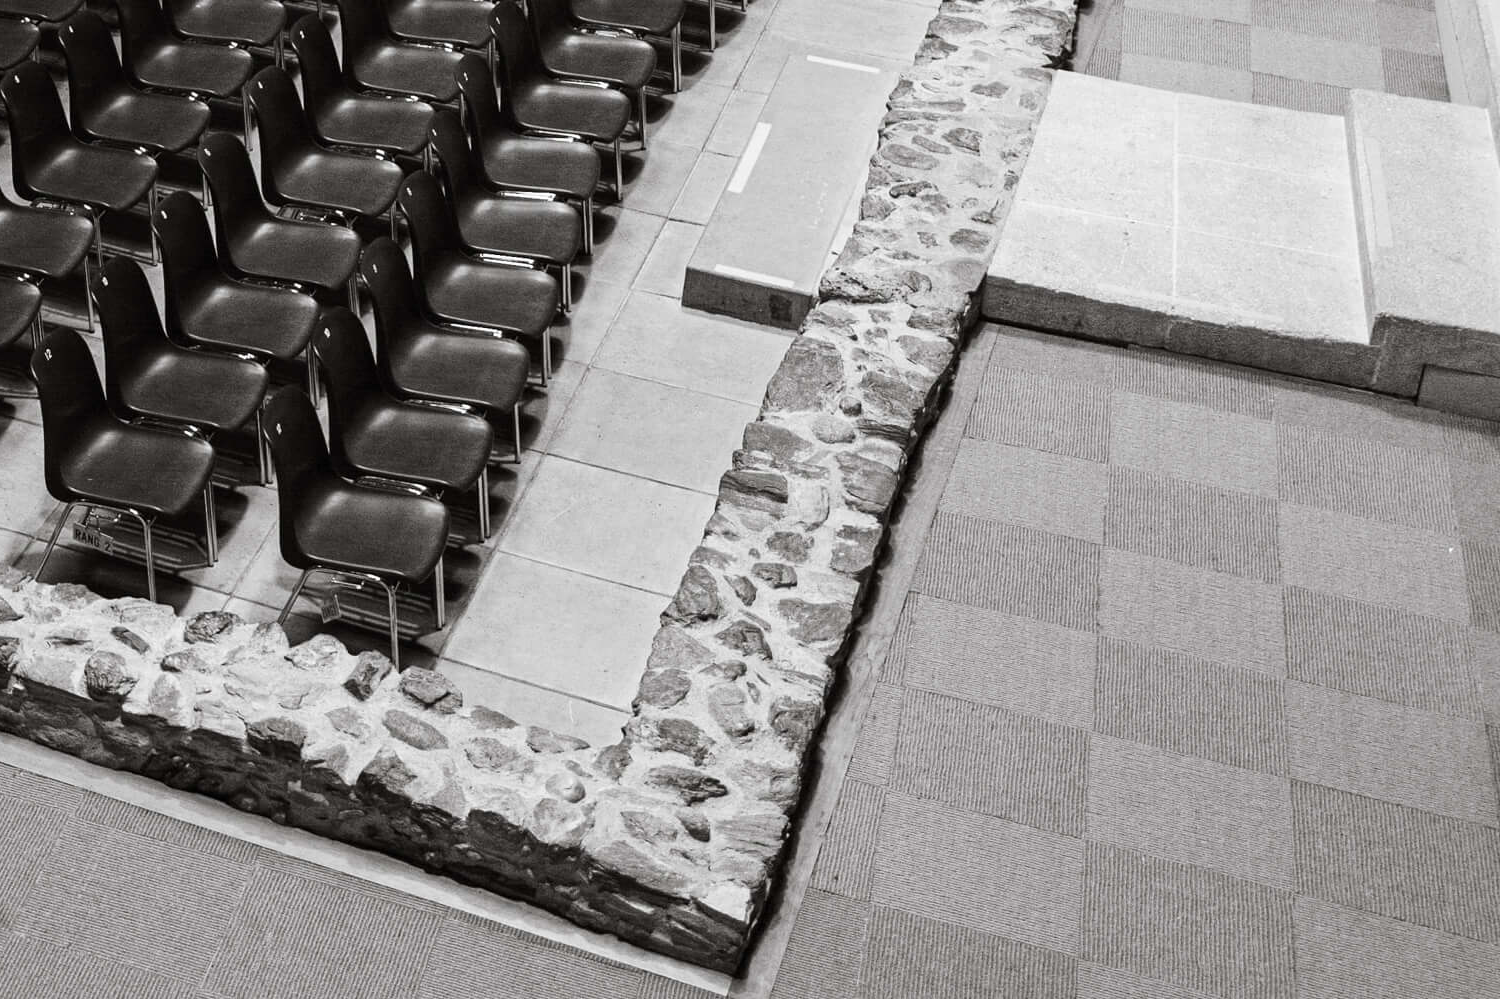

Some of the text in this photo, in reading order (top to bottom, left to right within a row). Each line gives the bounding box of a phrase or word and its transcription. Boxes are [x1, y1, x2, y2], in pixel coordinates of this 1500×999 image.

[44, 348, 53, 361] 12
[75, 528, 111, 553] RANG 2
